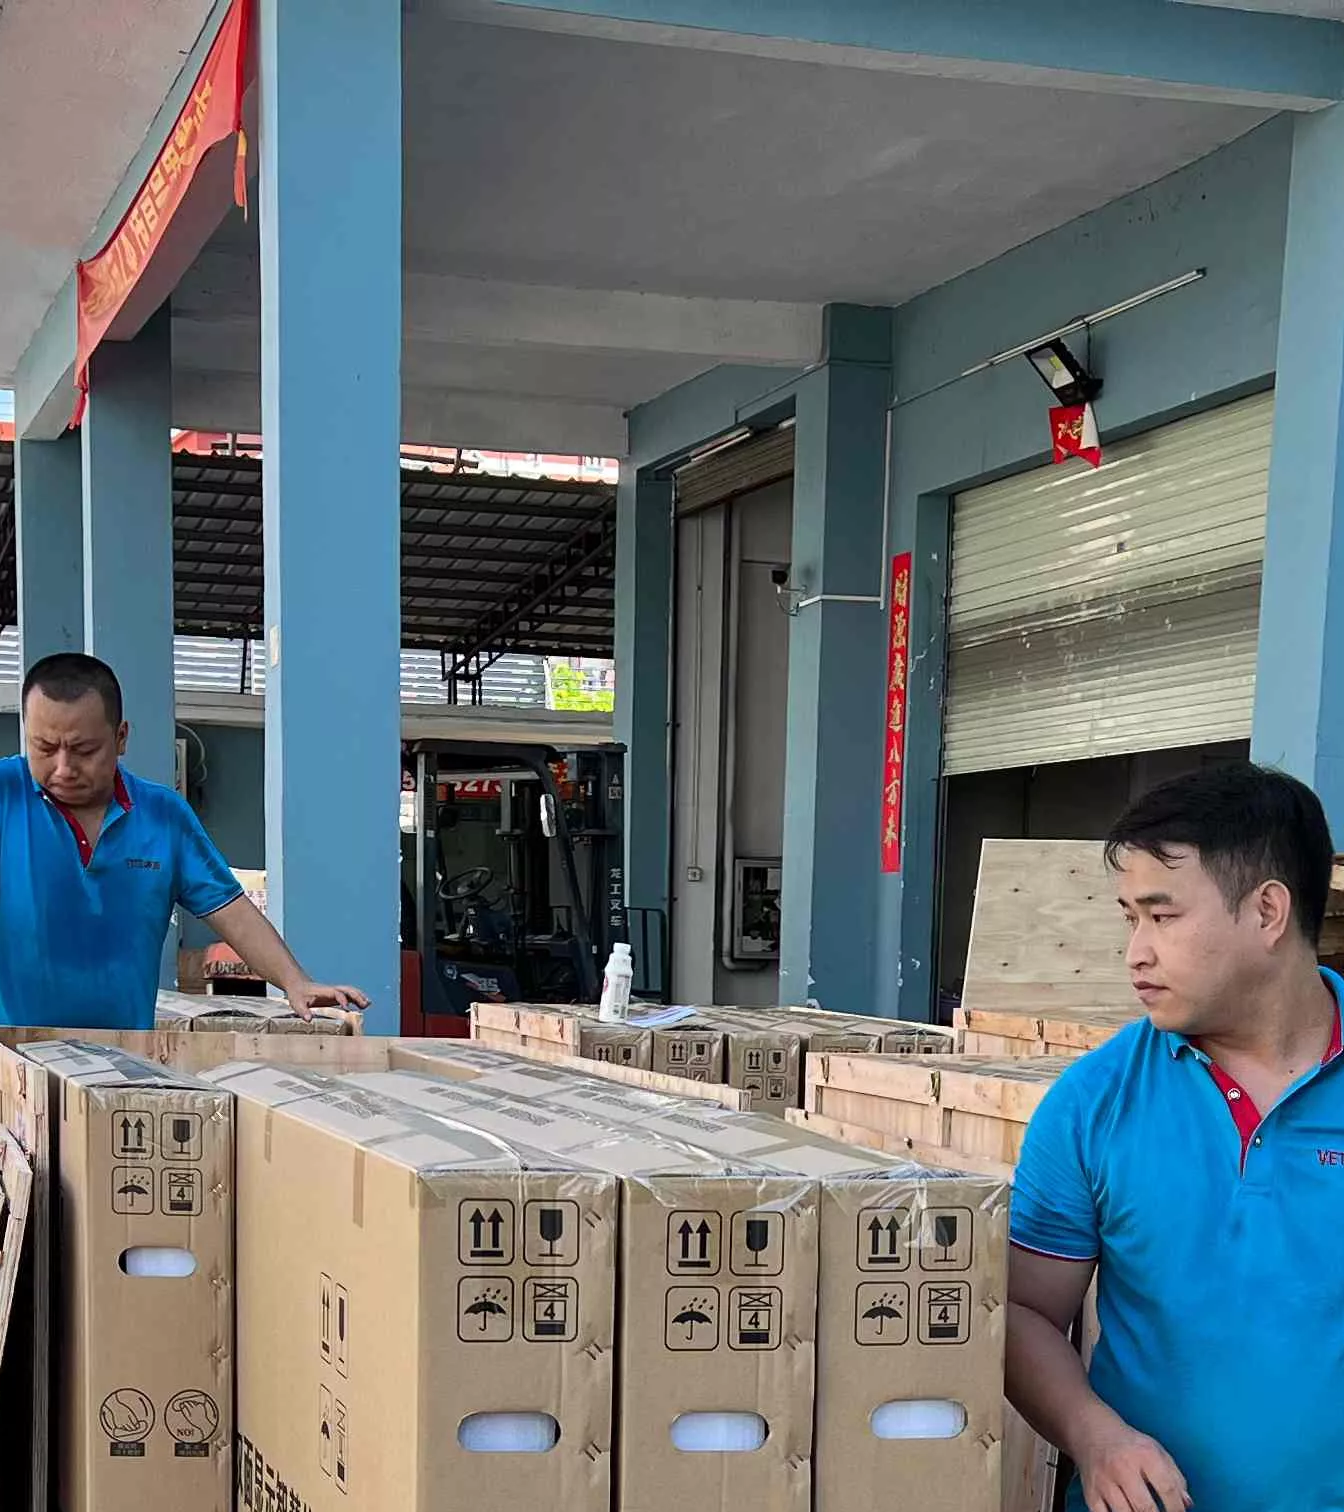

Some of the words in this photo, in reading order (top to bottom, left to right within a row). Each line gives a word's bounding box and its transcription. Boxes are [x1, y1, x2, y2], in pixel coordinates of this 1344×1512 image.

[176, 1186, 186, 1201] 4
[544, 1302, 556, 1320] 4
[747, 1311, 760, 1329] 4
[937, 1305, 949, 1323] 4
[176, 1428, 194, 1438] NO!
